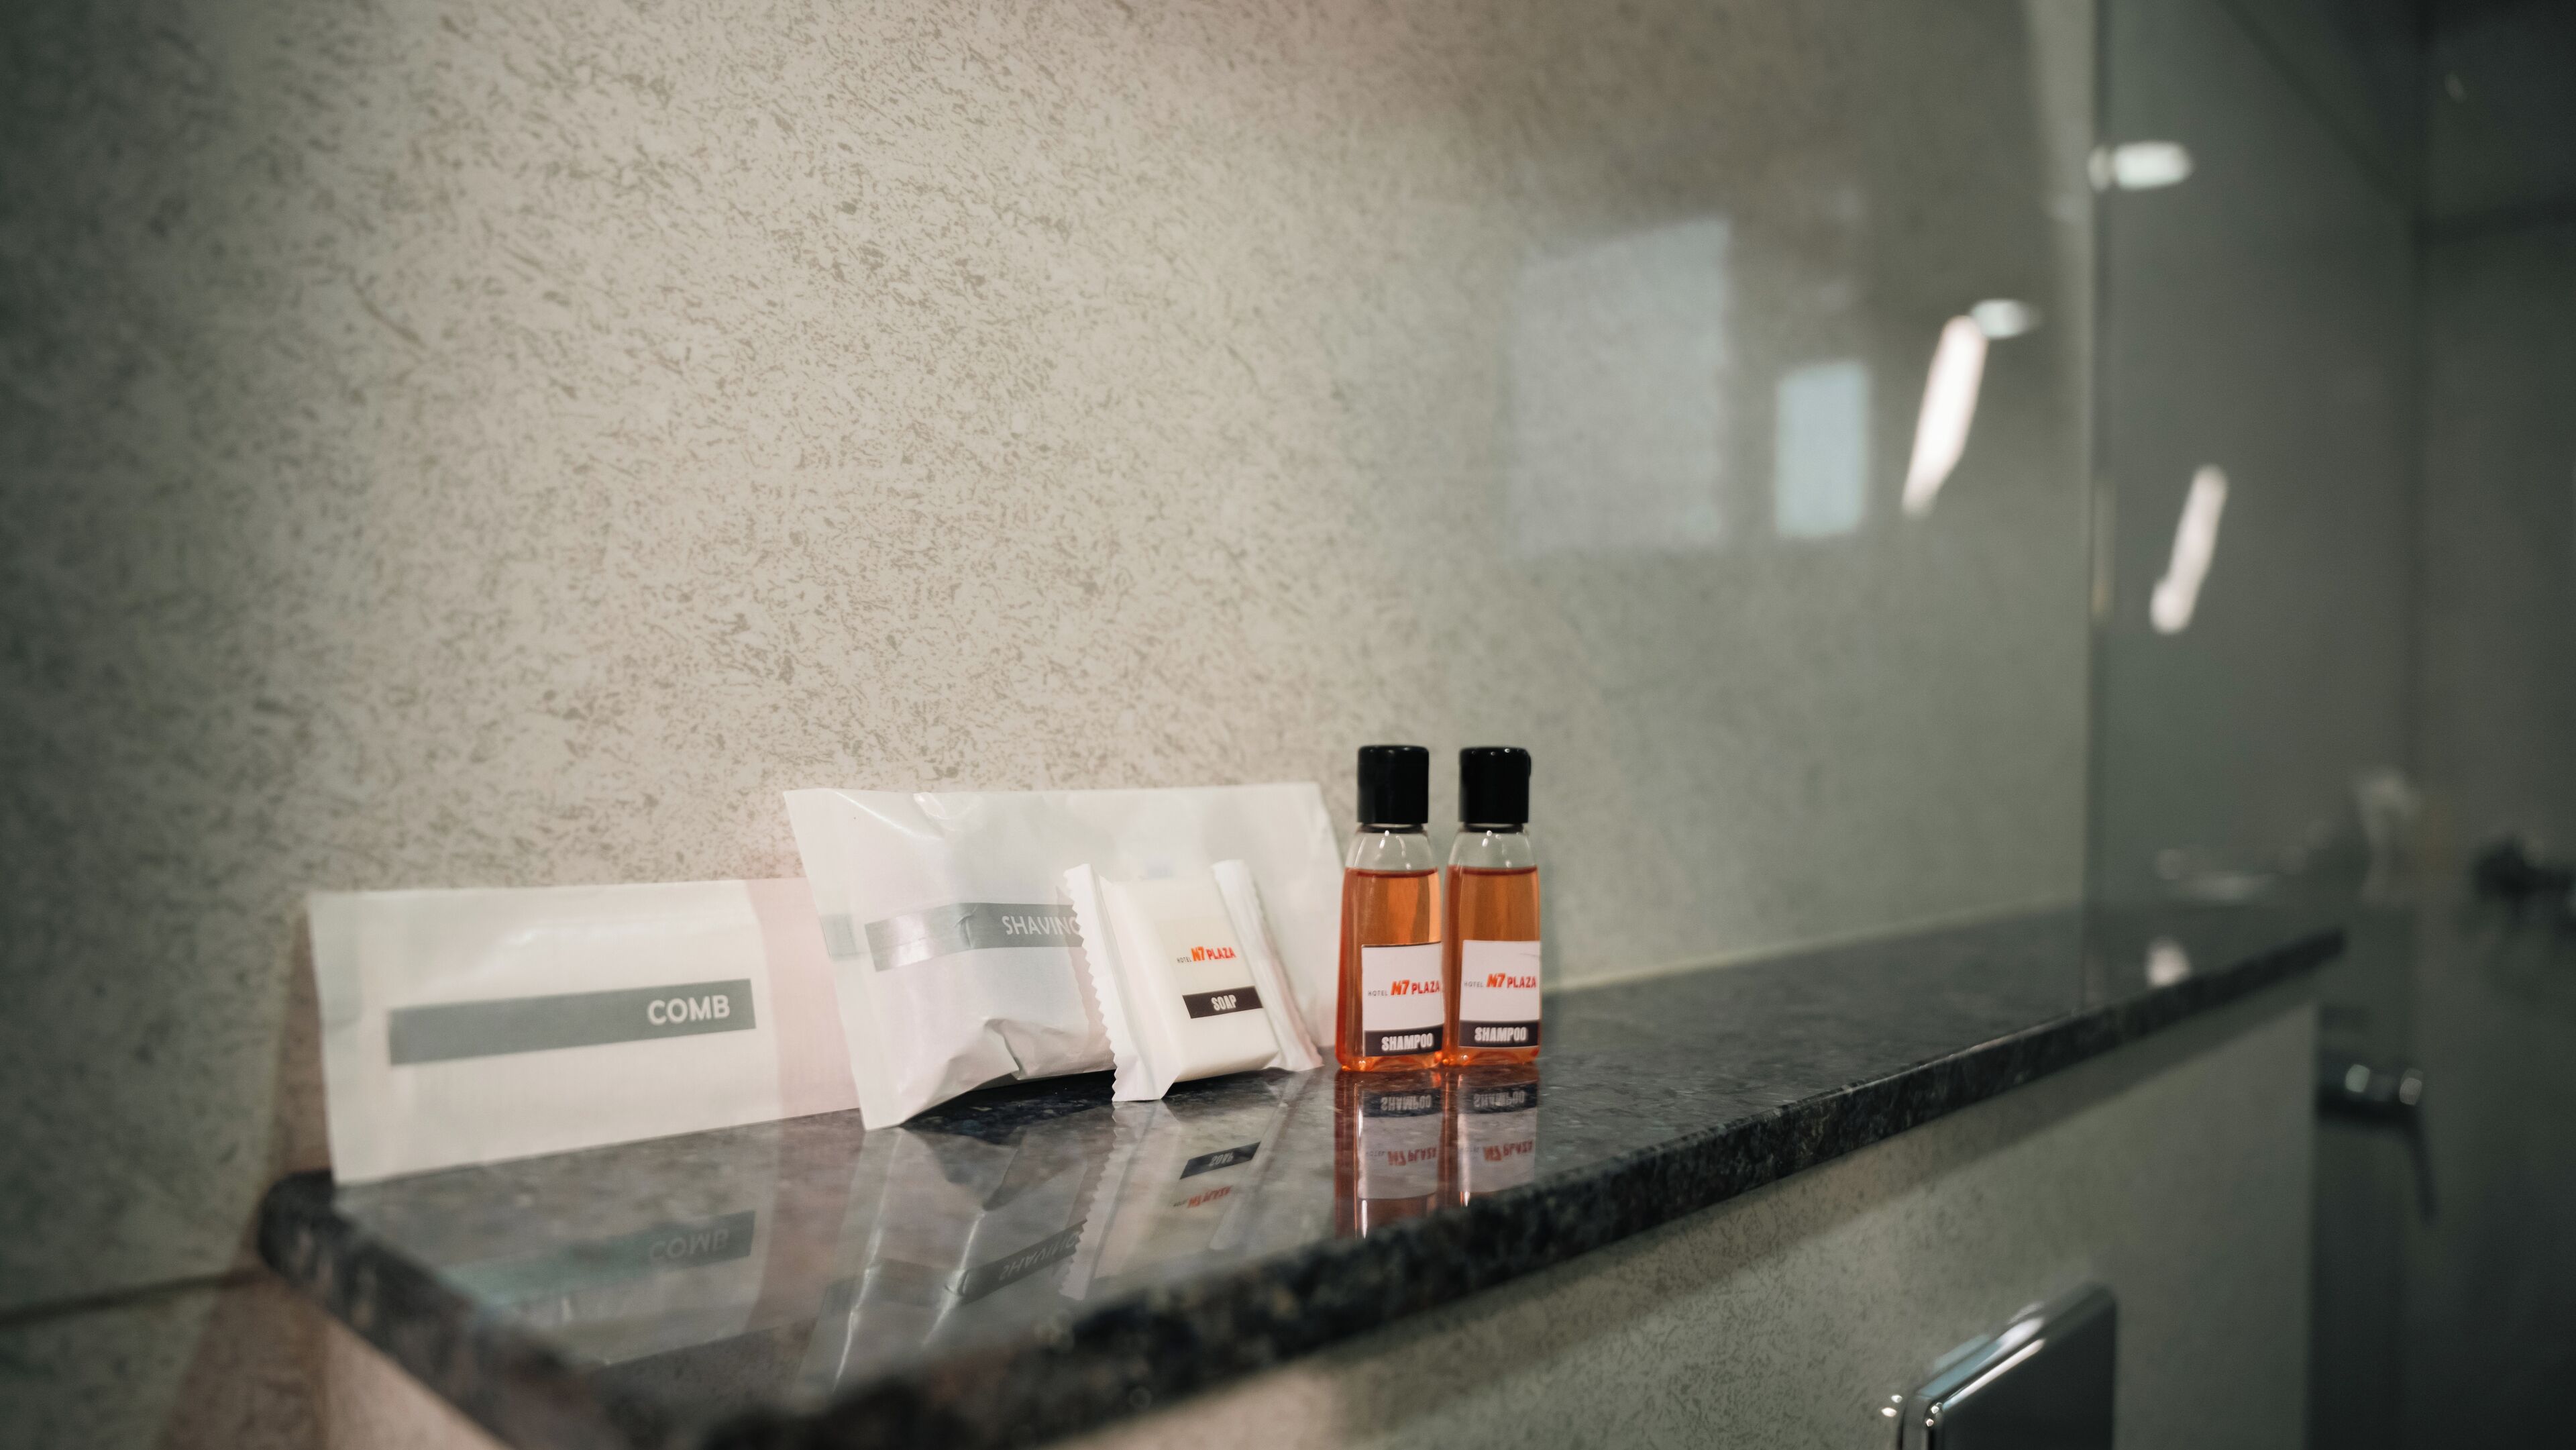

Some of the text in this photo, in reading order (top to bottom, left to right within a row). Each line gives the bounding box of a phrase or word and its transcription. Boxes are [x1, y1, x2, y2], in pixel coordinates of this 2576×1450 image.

[1191, 946, 1205, 962] N7
[1206, 947, 1237, 961] PLAZA
[1411, 980, 1440, 994] PLAZA
[1507, 976, 1536, 988] PLAZA
[647, 994, 731, 1025] COMB
[1211, 994, 1236, 1011] SOAP
[1381, 1033, 1434, 1051] SHAMPOO
[1474, 1025, 1527, 1043] SHAMPOO
